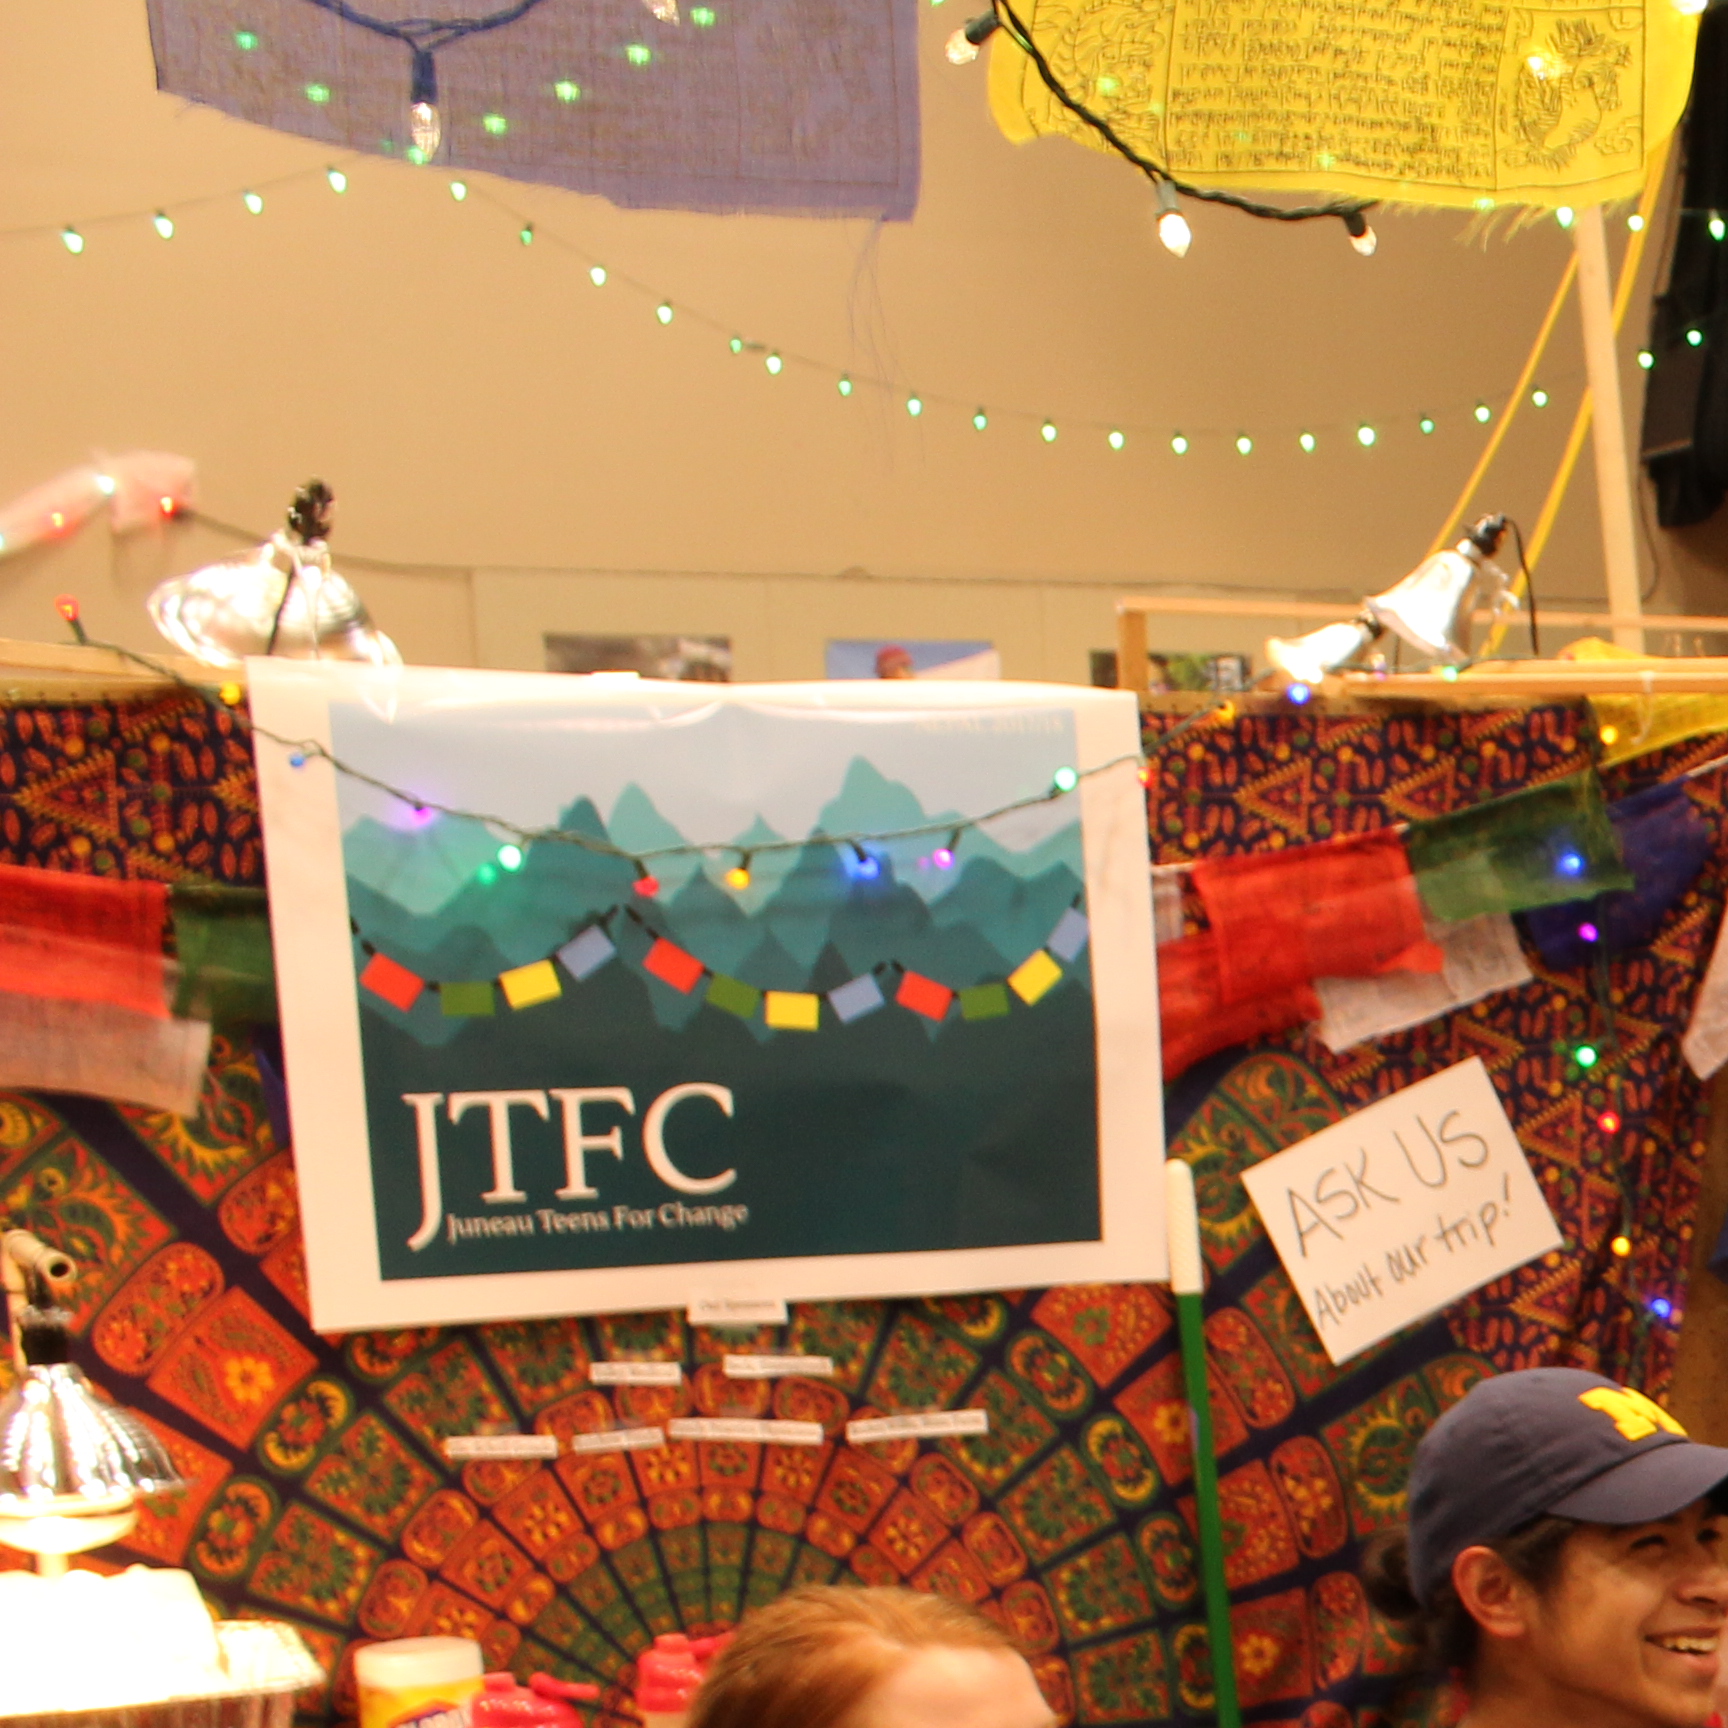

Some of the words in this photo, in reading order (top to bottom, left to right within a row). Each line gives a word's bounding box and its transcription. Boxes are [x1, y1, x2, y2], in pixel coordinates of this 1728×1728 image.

[401, 1081, 738, 1251] JTFC
[446, 1212, 534, 1243] Juneau
[537, 1205, 609, 1236] Teens
[612, 1202, 653, 1232] For
[654, 1200, 749, 1231] Change
[1287, 1147, 1400, 1258] ASK
[1393, 1108, 1489, 1188] US
[1313, 1263, 1382, 1330] About
[1436, 1171, 1511, 1247] trip!
